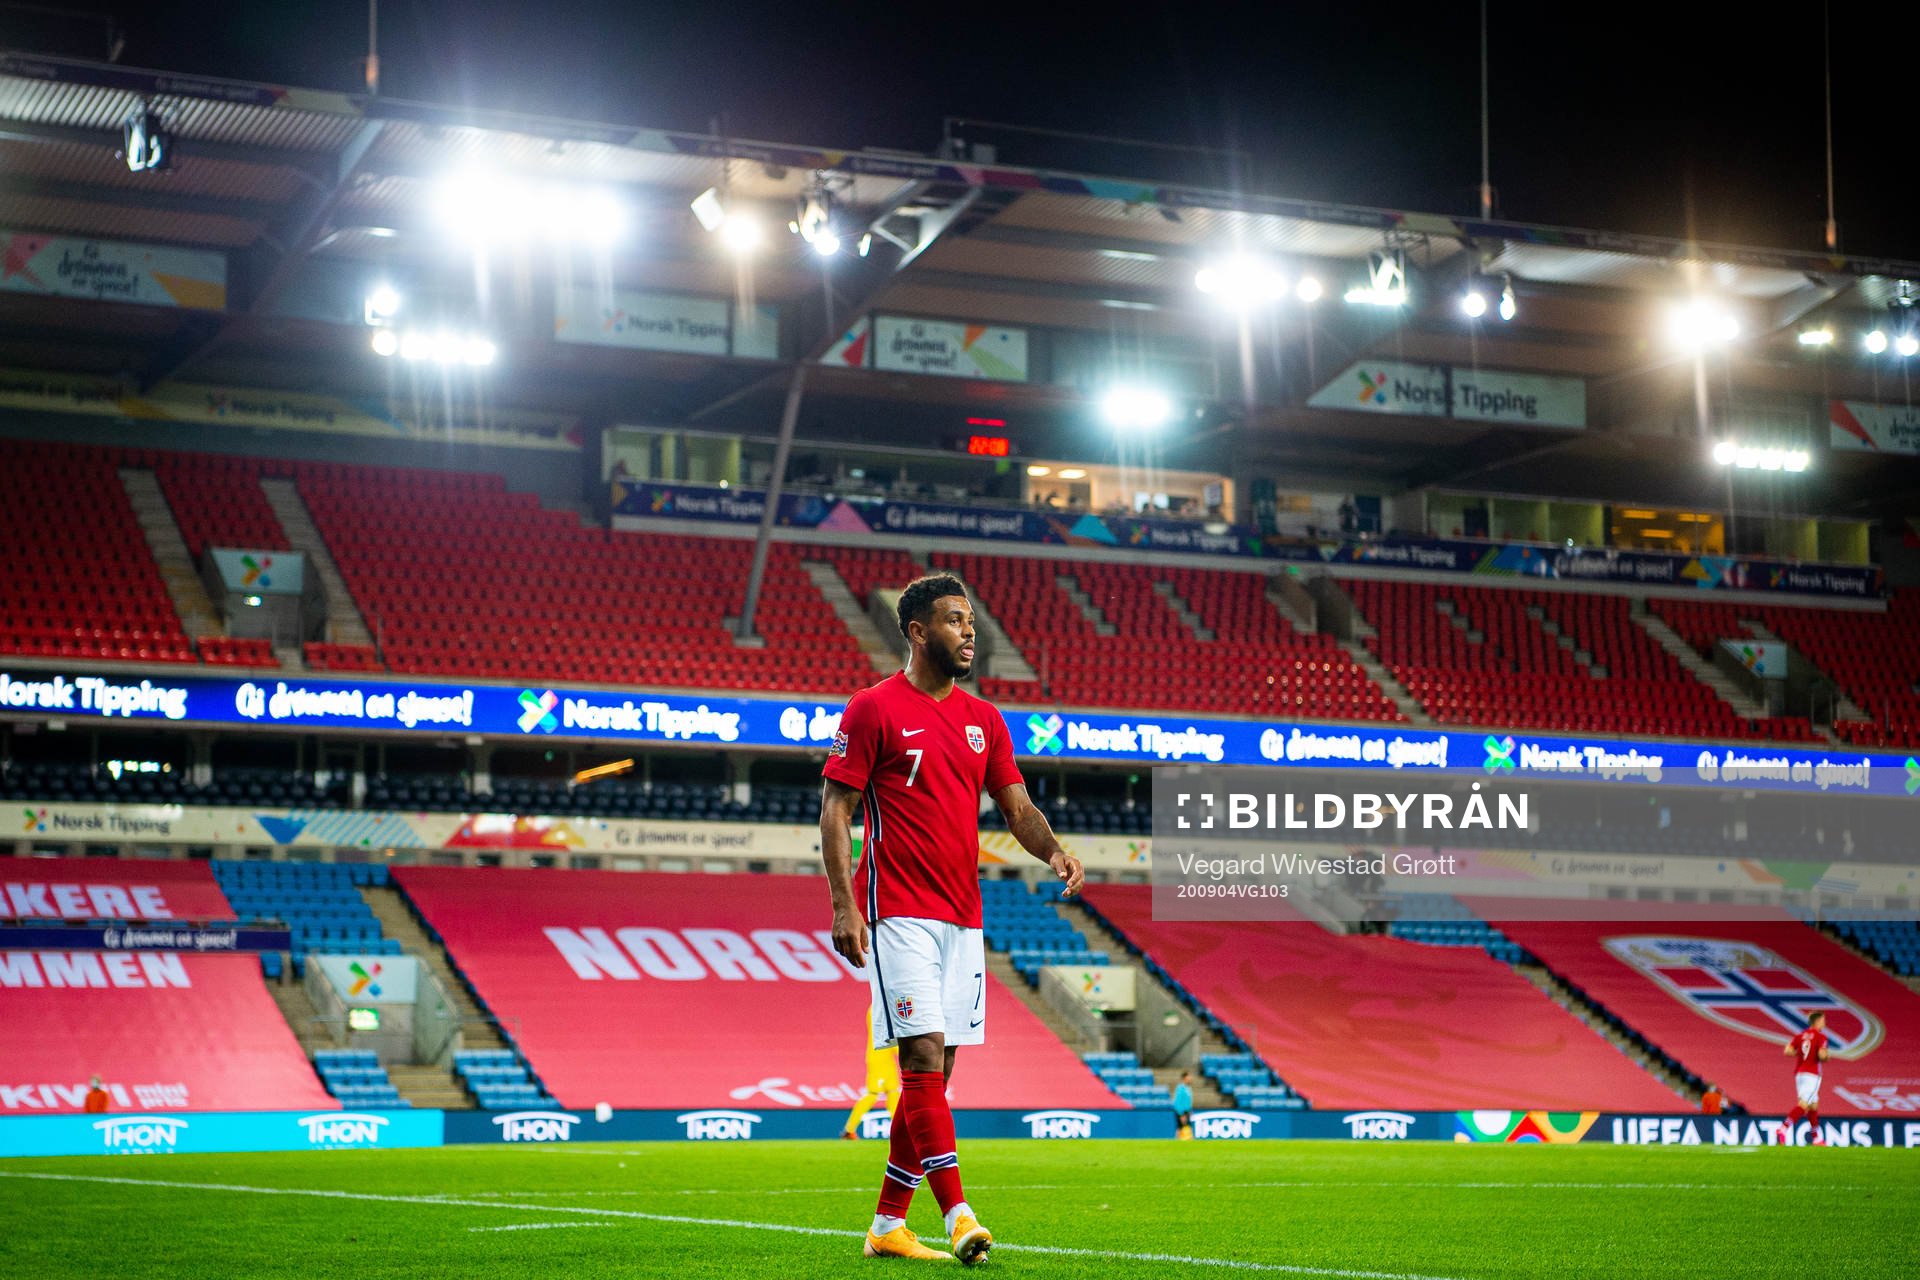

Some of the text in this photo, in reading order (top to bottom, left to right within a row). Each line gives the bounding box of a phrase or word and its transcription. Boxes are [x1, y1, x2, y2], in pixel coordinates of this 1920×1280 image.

[1394, 378, 1538, 420] Nors Tipping
[75, 678, 188, 720] Tipping
[563, 698, 741, 742] Norsk Tipping
[1067, 721, 1225, 762] Norsk Tipping
[905, 749, 924, 788] 7
[1520, 743, 1664, 783] Norsk Tipping
[52, 811, 171, 837] Norsk Tipping
[0, 883, 174, 919] KERE
[543, 926, 872, 982] NORG
[973, 972, 982, 1010] 7
[1801, 1039, 1812, 1061] 9
[93, 1116, 189, 1147] THON
[298, 1113, 390, 1145] THON
[492, 1111, 581, 1142] THON
[677, 1110, 762, 1141] THON
[1022, 1110, 1101, 1140] THON
[1191, 1110, 1261, 1140] THON
[1342, 1110, 1416, 1139] THON
[1713, 1118, 1872, 1148] NATIONS
